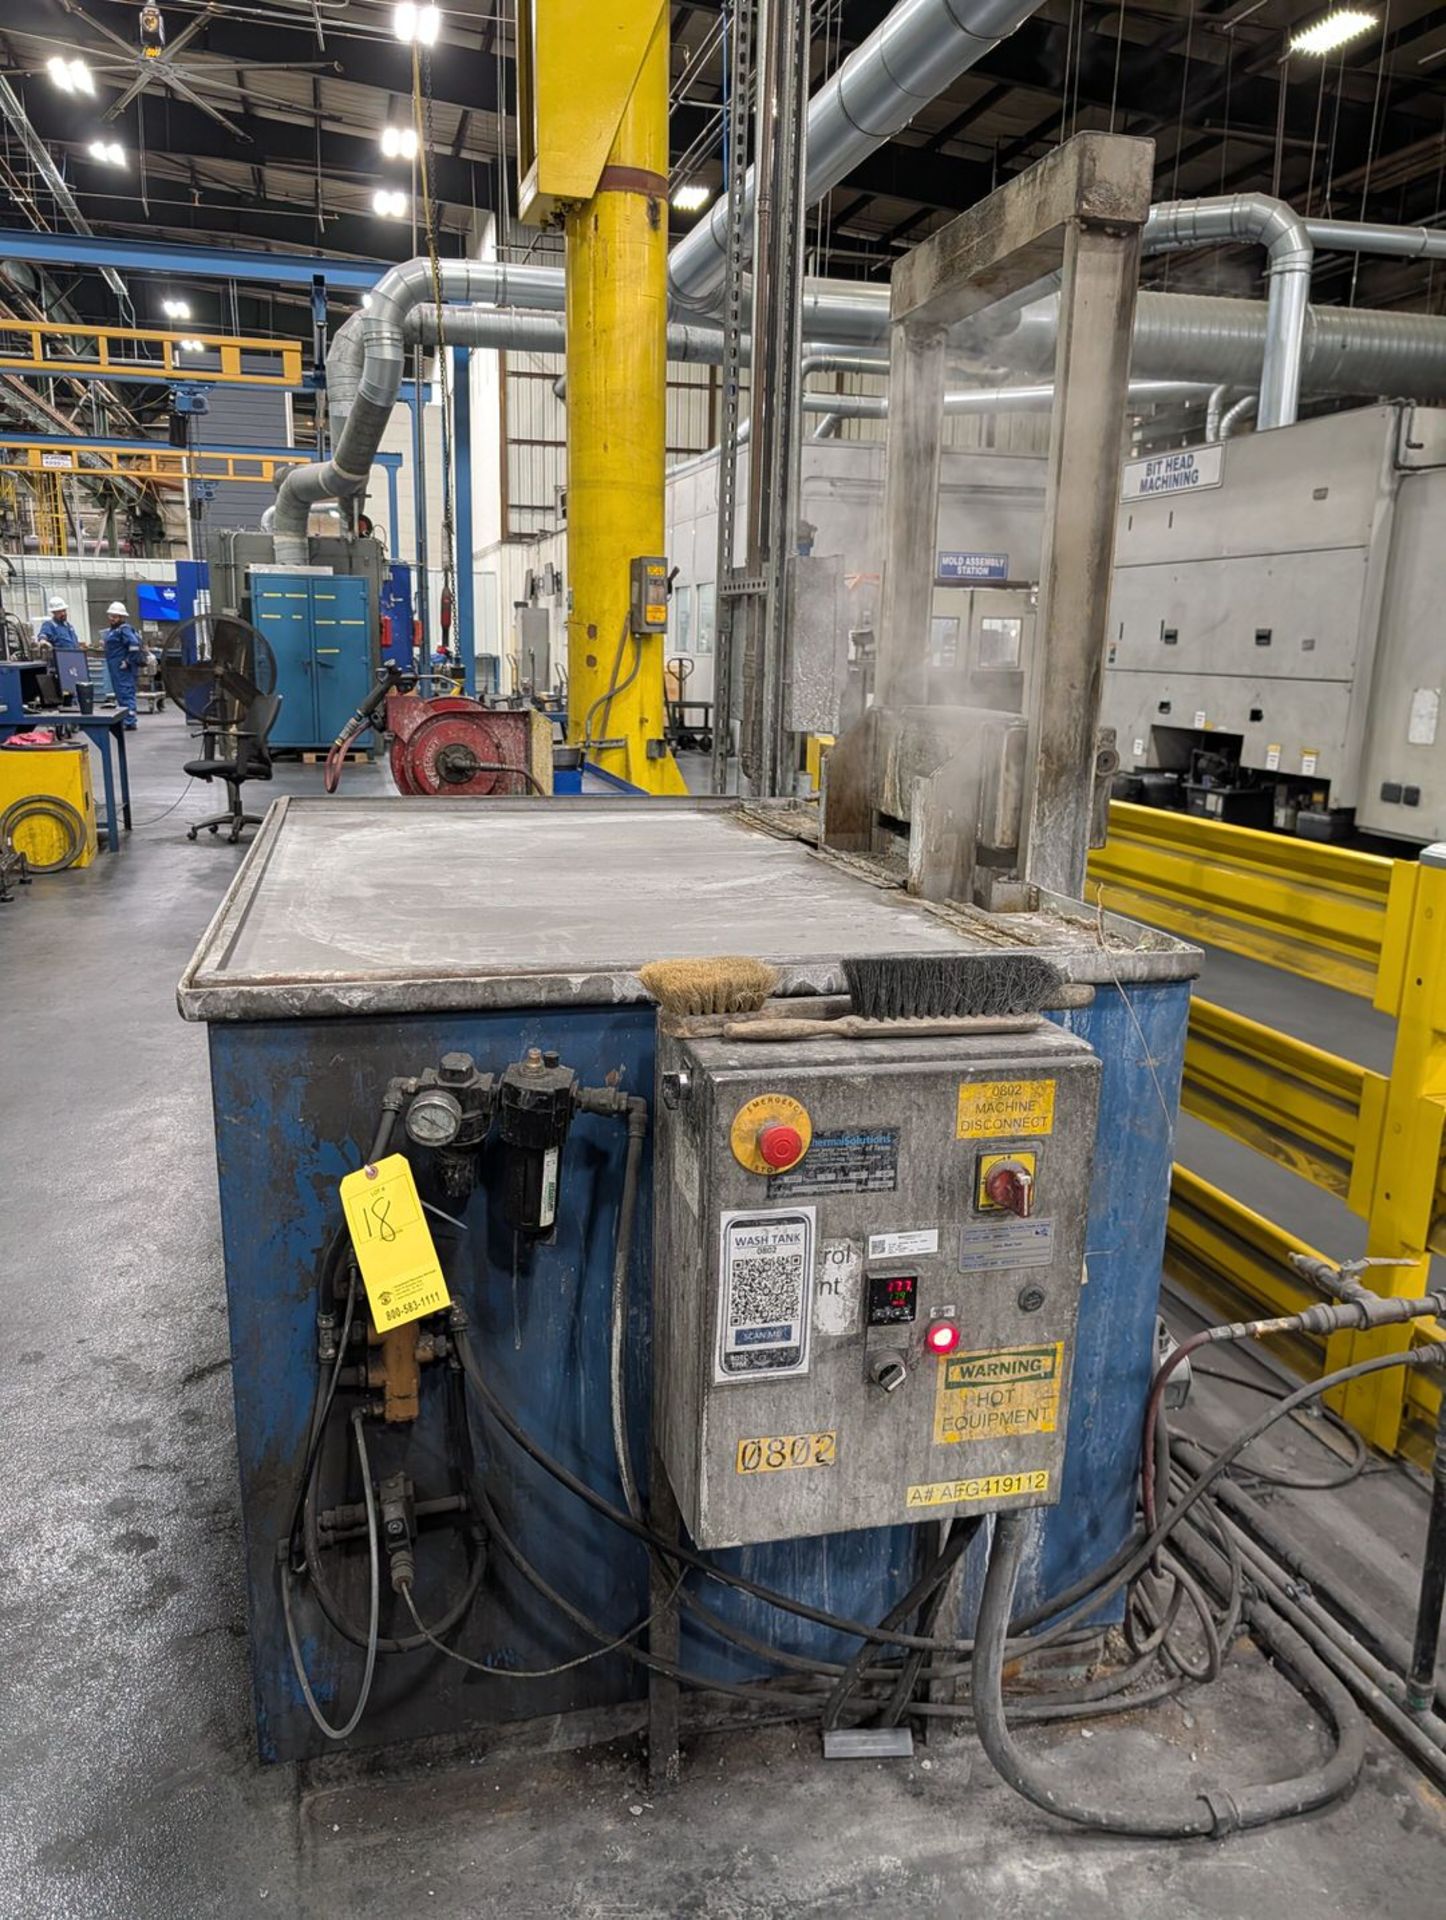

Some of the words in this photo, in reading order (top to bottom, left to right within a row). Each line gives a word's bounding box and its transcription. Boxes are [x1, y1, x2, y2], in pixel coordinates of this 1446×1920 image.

[1146, 461, 1163, 476] BIT
[1165, 454, 1194, 473] HEAD
[1140, 469, 1199, 492] MACHINING
[942, 557, 964, 565] MOLD
[965, 557, 1004, 567] ASSEMBLY
[957, 566, 990, 575] STATION
[992, 1085, 1022, 1097] 0802
[746, 1096, 805, 1115] EMERGENCY
[975, 1100, 1037, 1114] MACHINE
[961, 1116, 1048, 1131] DISCONNECT
[811, 1135, 891, 1147] hermalSolutions
[363, 1197, 396, 1242] 18
[734, 1236, 768, 1246] WASH
[773, 1233, 801, 1245] TANK
[819, 1277, 841, 1296] nt
[960, 1359, 1042, 1379] WARNING
[977, 1388, 1015, 1408] HOT
[942, 1407, 1049, 1432] EQUIPMENT
[909, 1486, 933, 1504] A#
